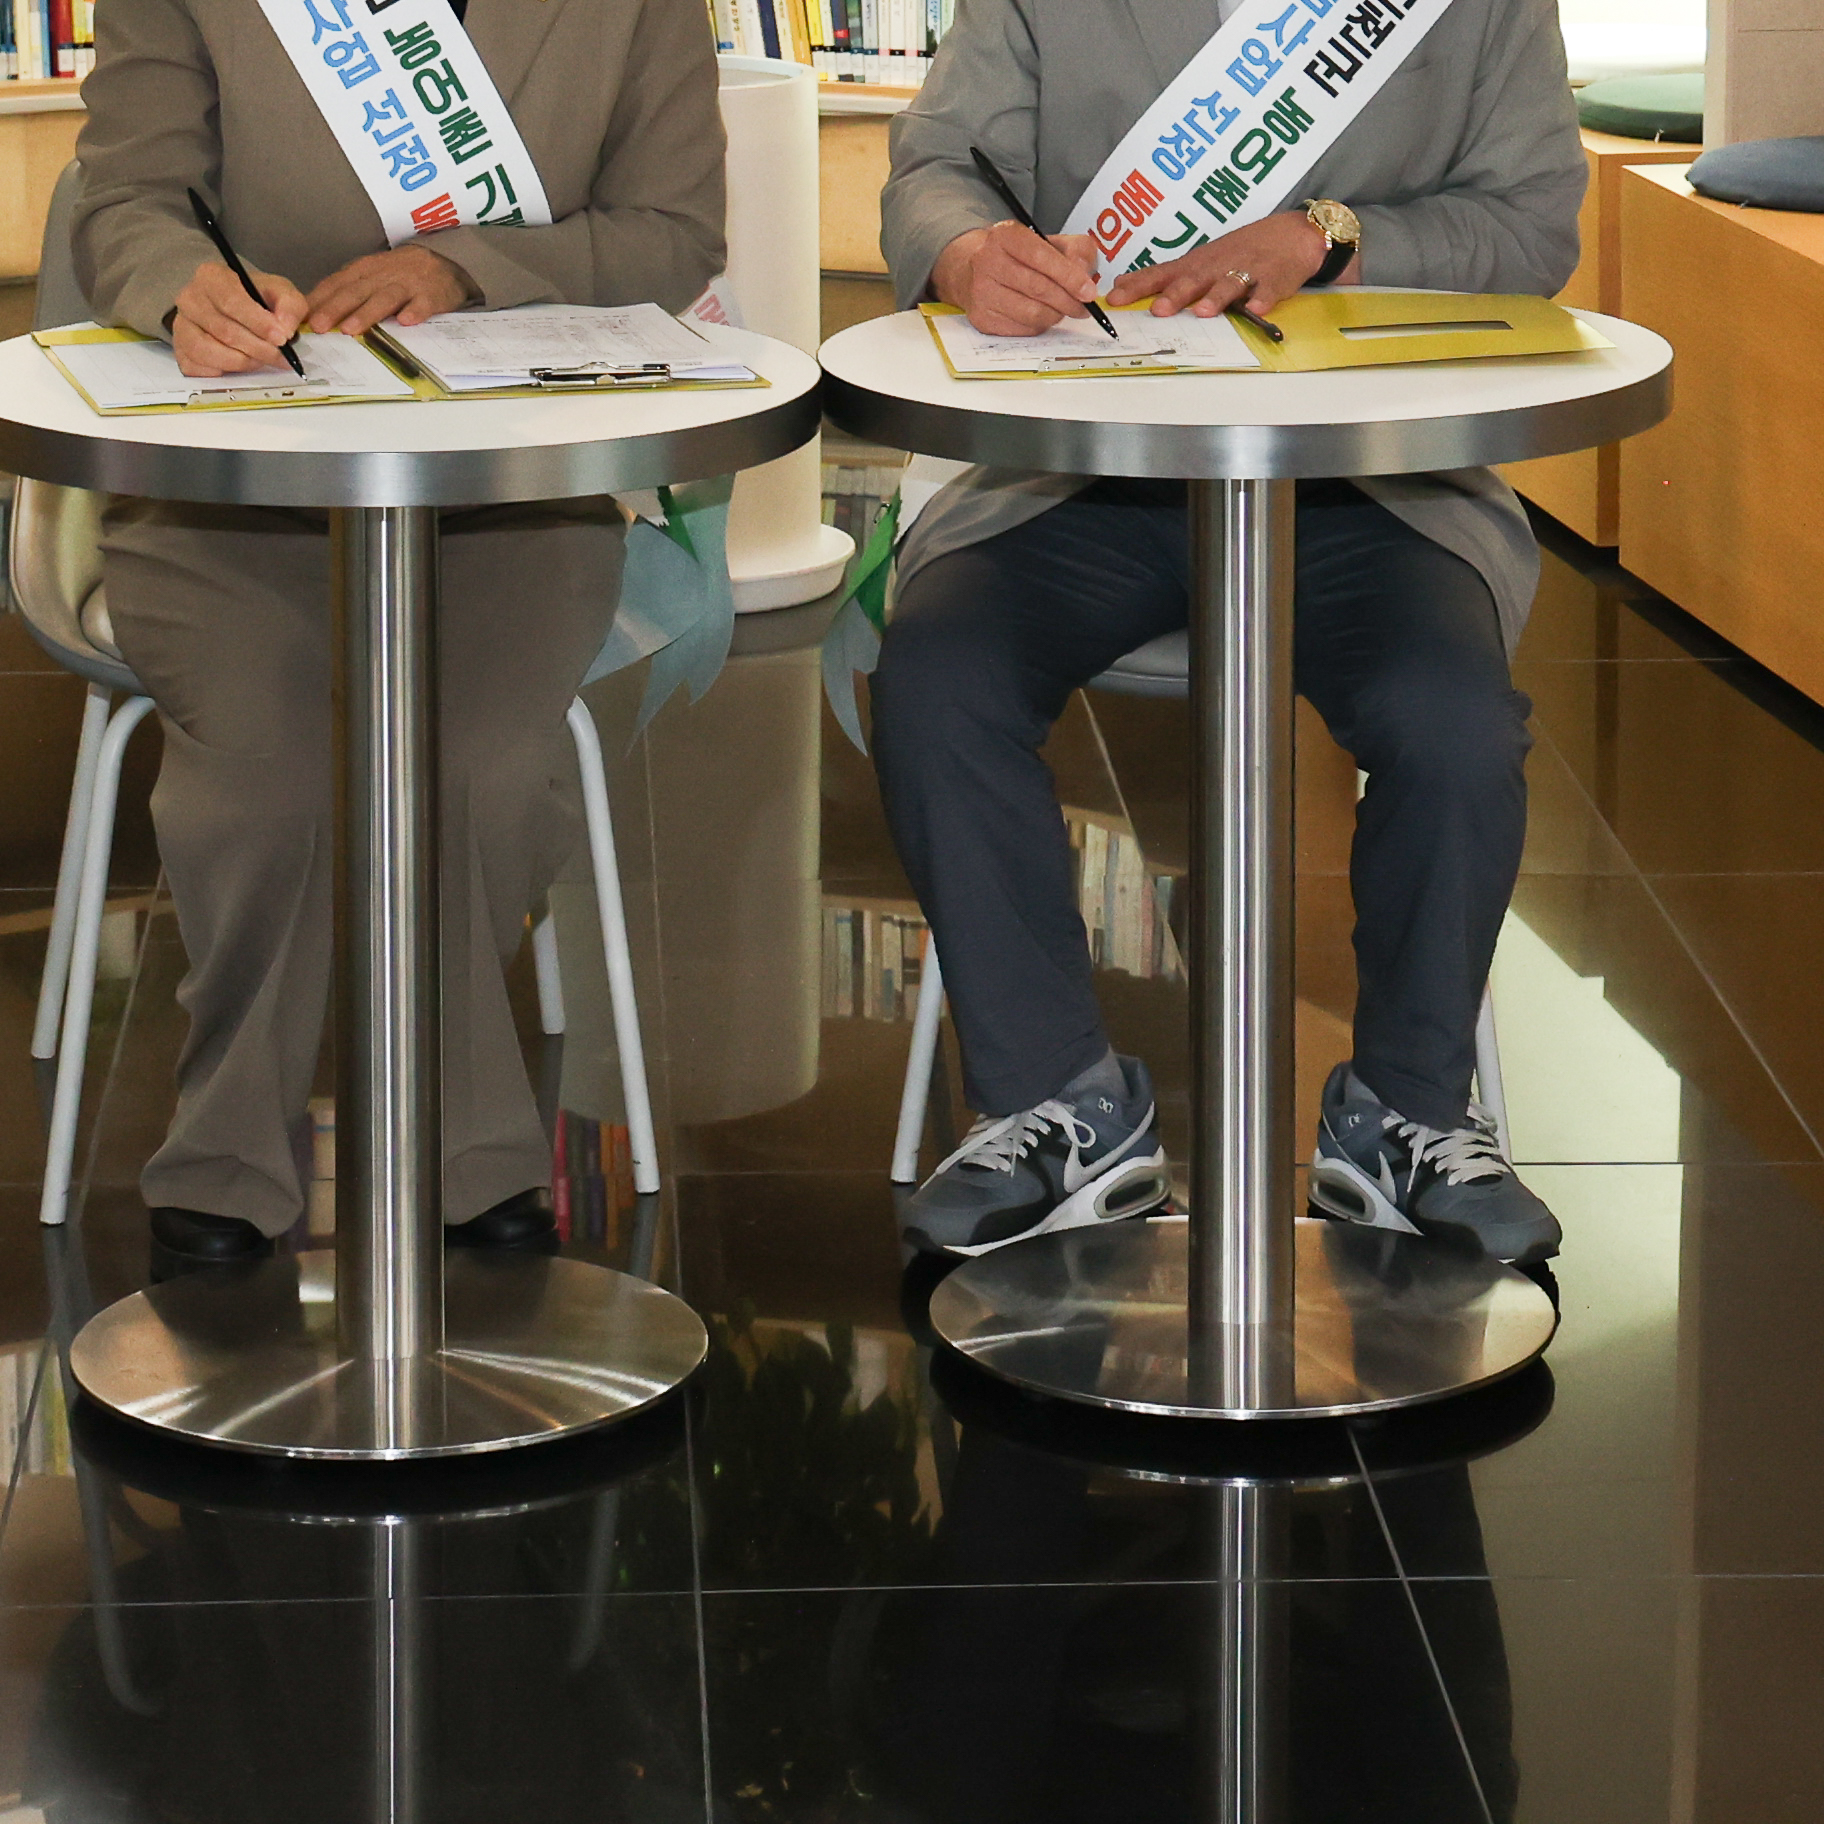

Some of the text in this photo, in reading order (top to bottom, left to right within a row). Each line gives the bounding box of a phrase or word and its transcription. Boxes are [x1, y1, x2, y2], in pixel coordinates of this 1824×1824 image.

[362, 88, 438, 191] 선정
[384, 21, 493, 166] 농어촌
[1151, 89, 1241, 181] 선정
[1192, 85, 1316, 224] 농어촌
[1087, 168, 1165, 263] 동의
